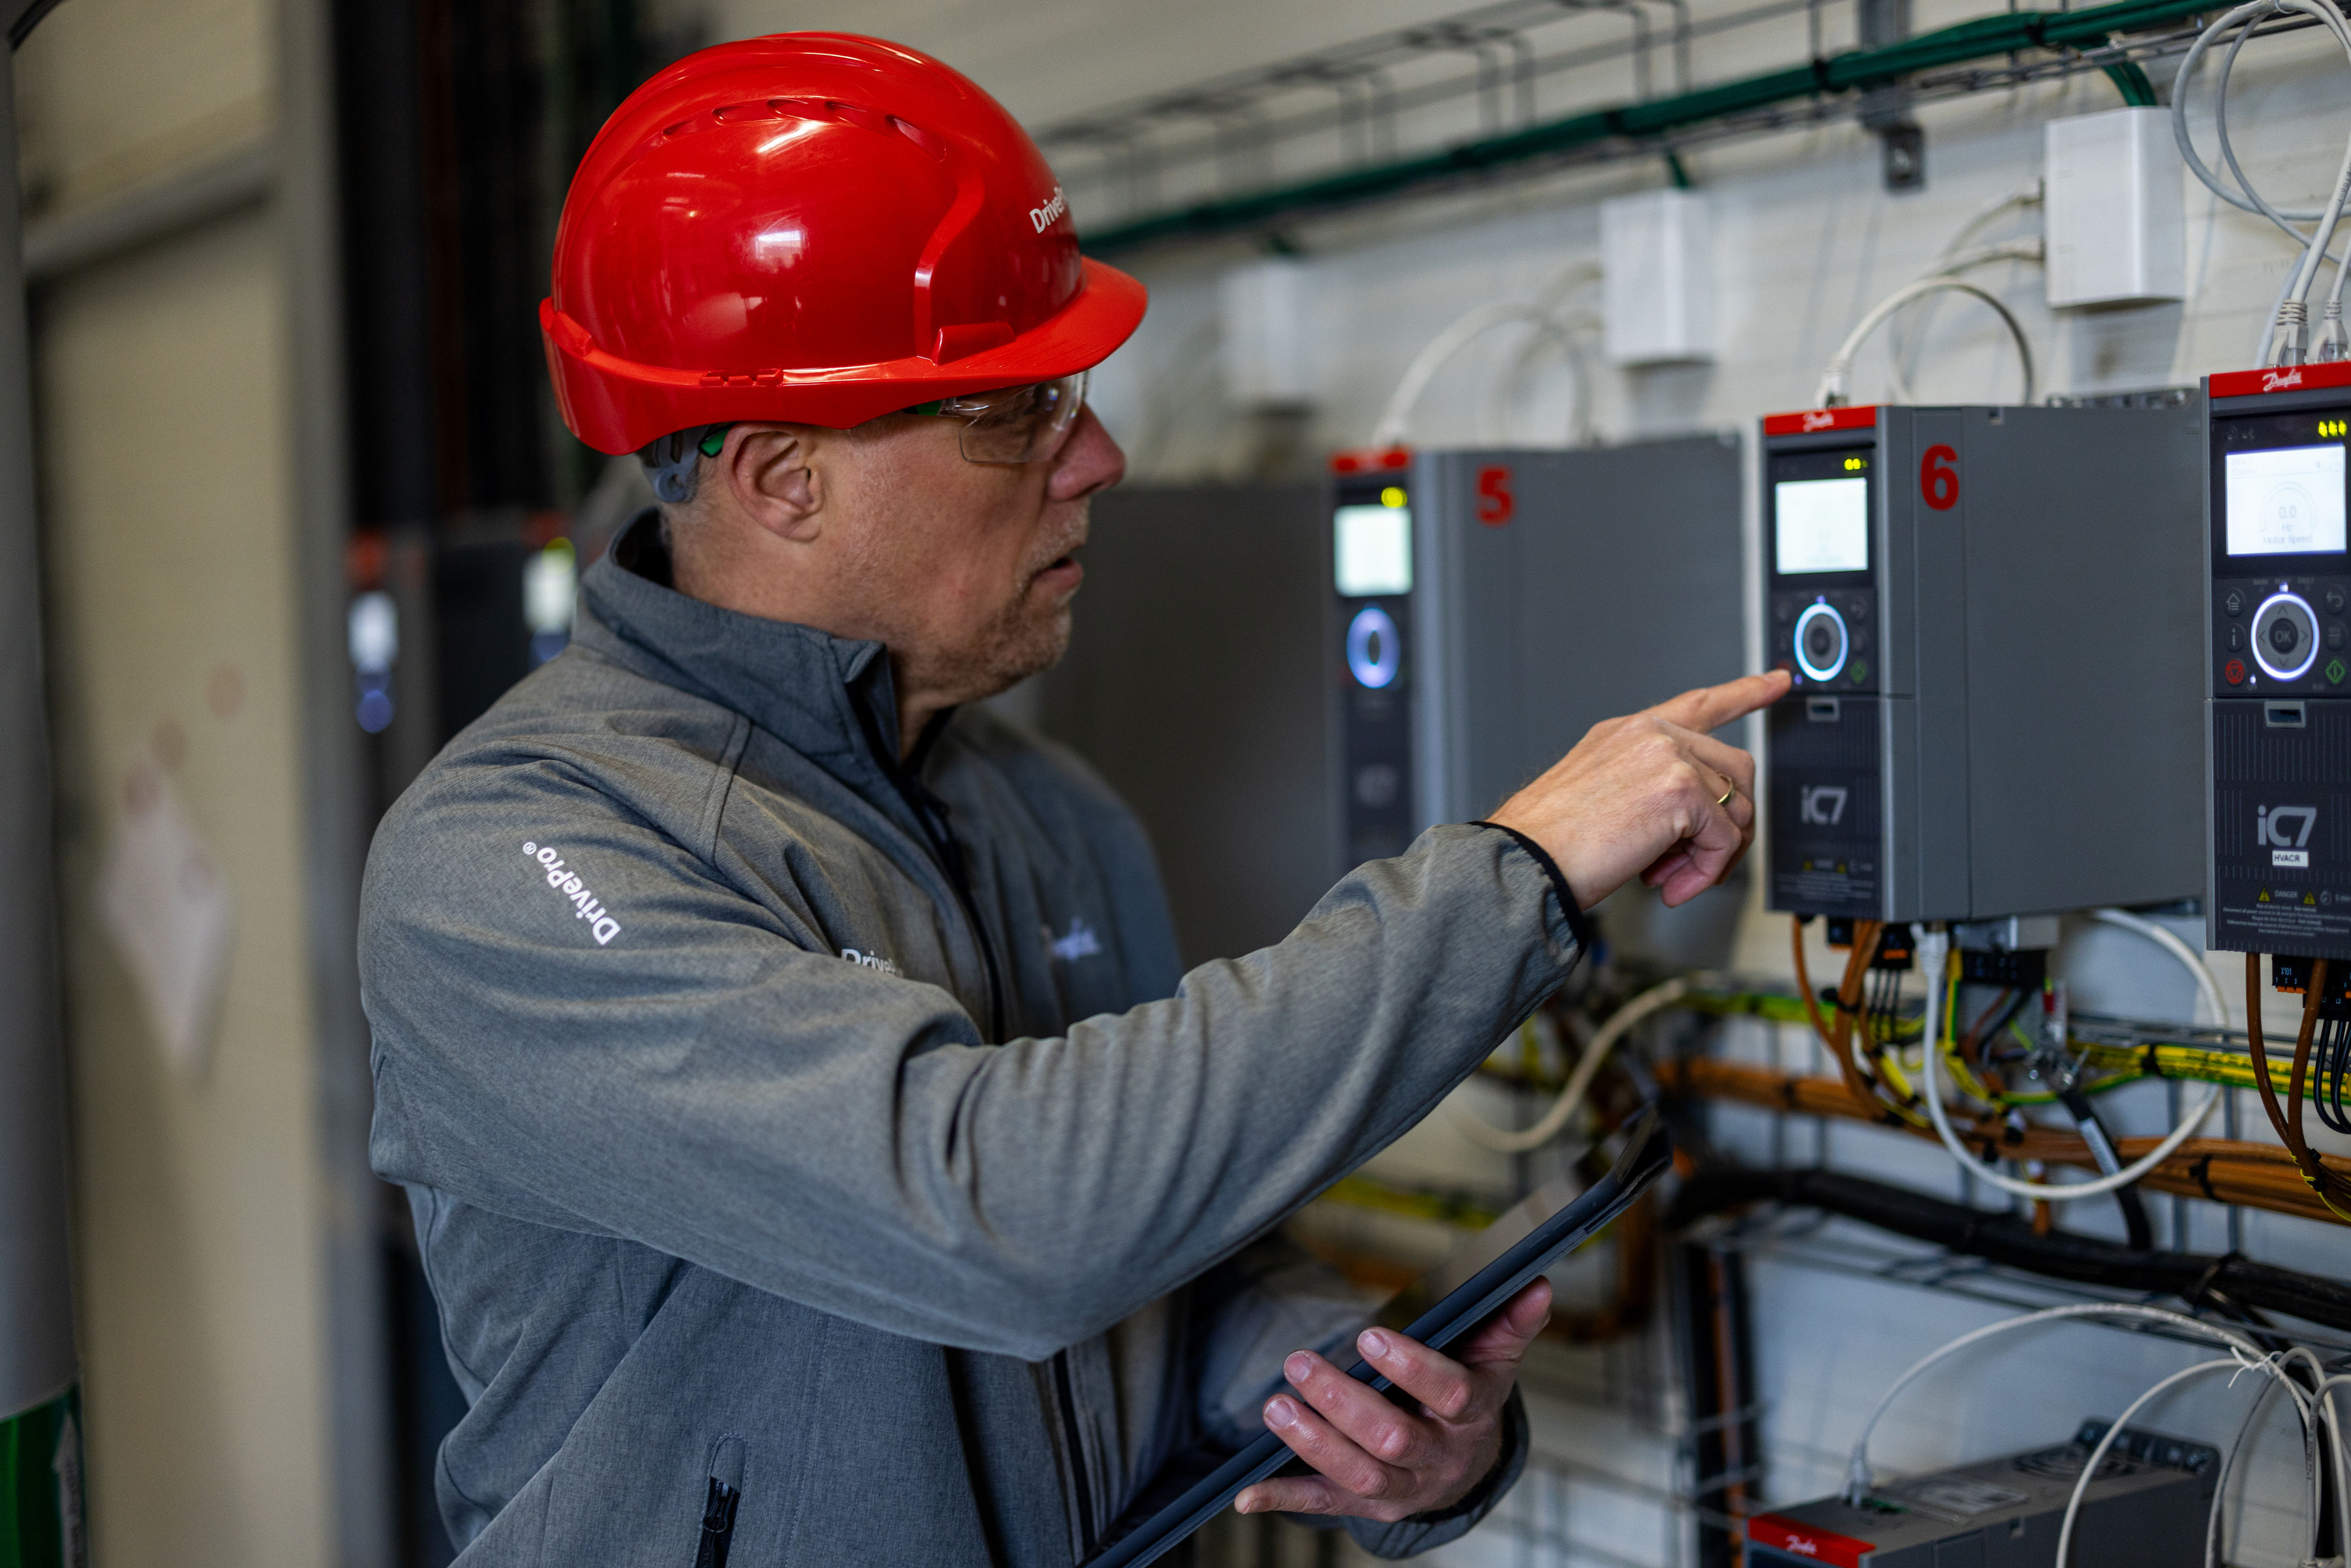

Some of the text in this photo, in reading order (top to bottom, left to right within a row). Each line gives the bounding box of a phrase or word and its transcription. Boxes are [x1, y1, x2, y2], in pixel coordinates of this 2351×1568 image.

[1921, 443, 1959, 511] 6
[1477, 464, 1514, 527] 5
[2279, 505, 2297, 519] 0.0
[2275, 630, 2292, 643] OK
[2258, 805, 2318, 847] iC7
[2273, 854, 2300, 863] HVACR
[2275, 889, 2298, 899] DANGER
[2280, 967, 2292, 976] X101
